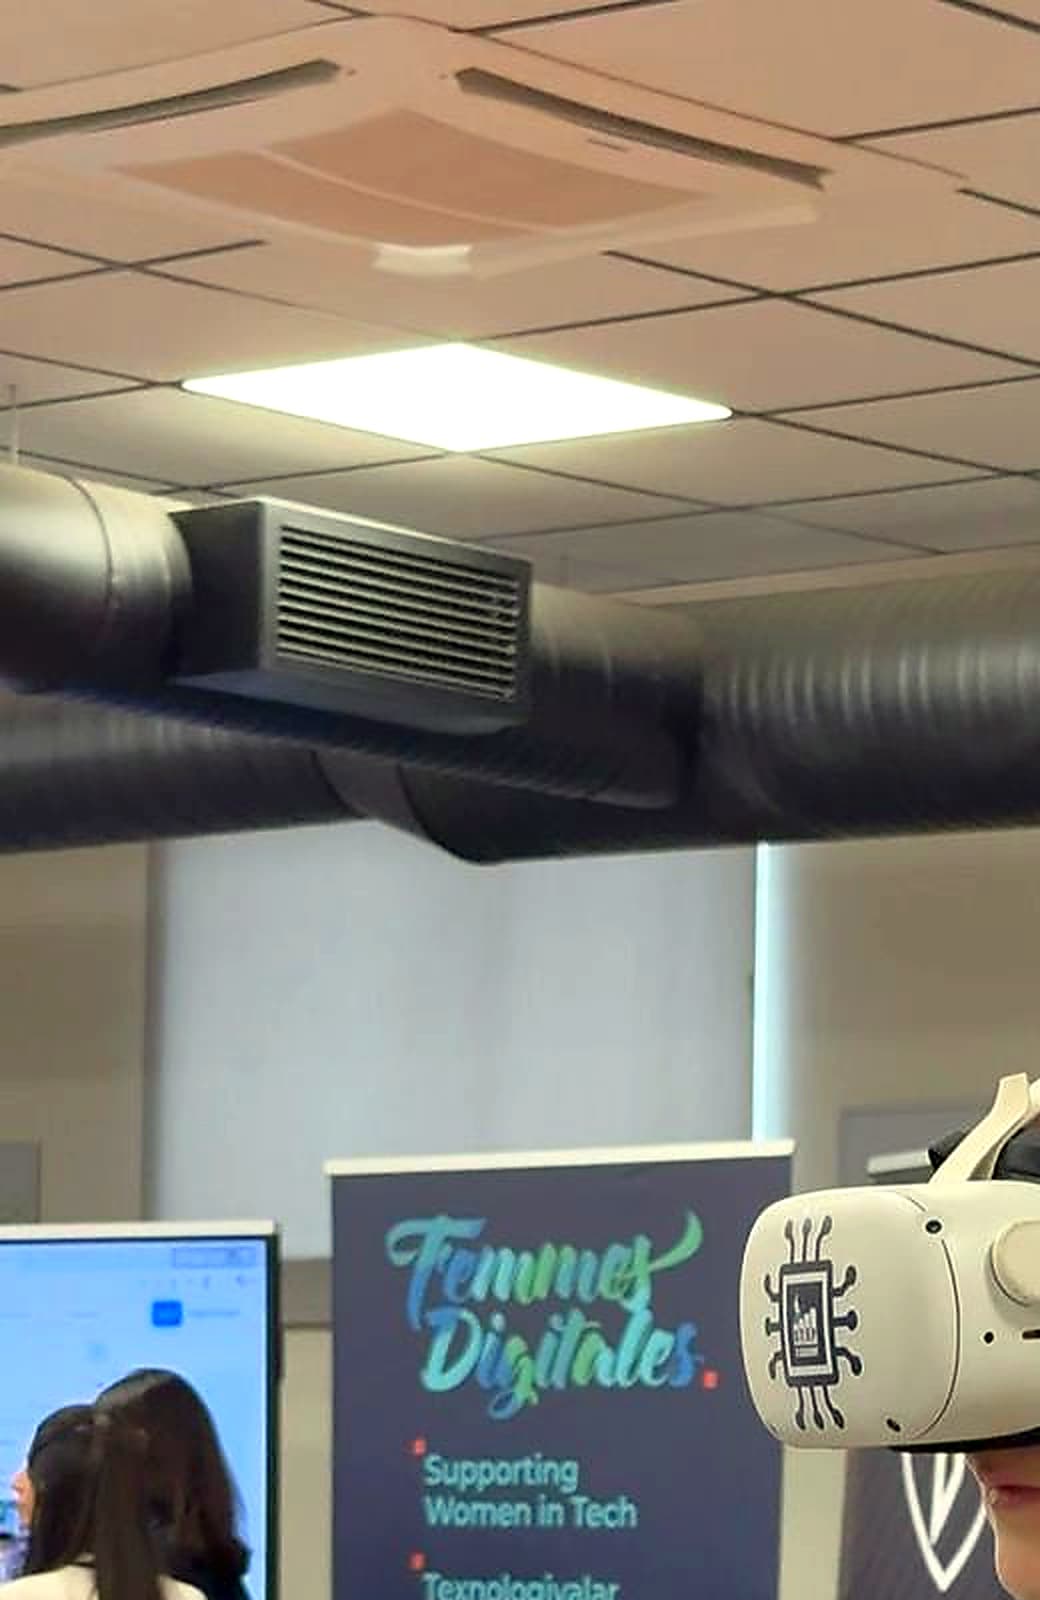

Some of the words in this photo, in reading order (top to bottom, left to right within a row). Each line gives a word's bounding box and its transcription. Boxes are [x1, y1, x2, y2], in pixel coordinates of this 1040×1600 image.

[384, 1210, 703, 1333] Femmes
[423, 1453, 579, 1494] Supporting
[424, 1496, 532, 1527] Women
[537, 1496, 565, 1527] in
[571, 1496, 639, 1529] Tech
